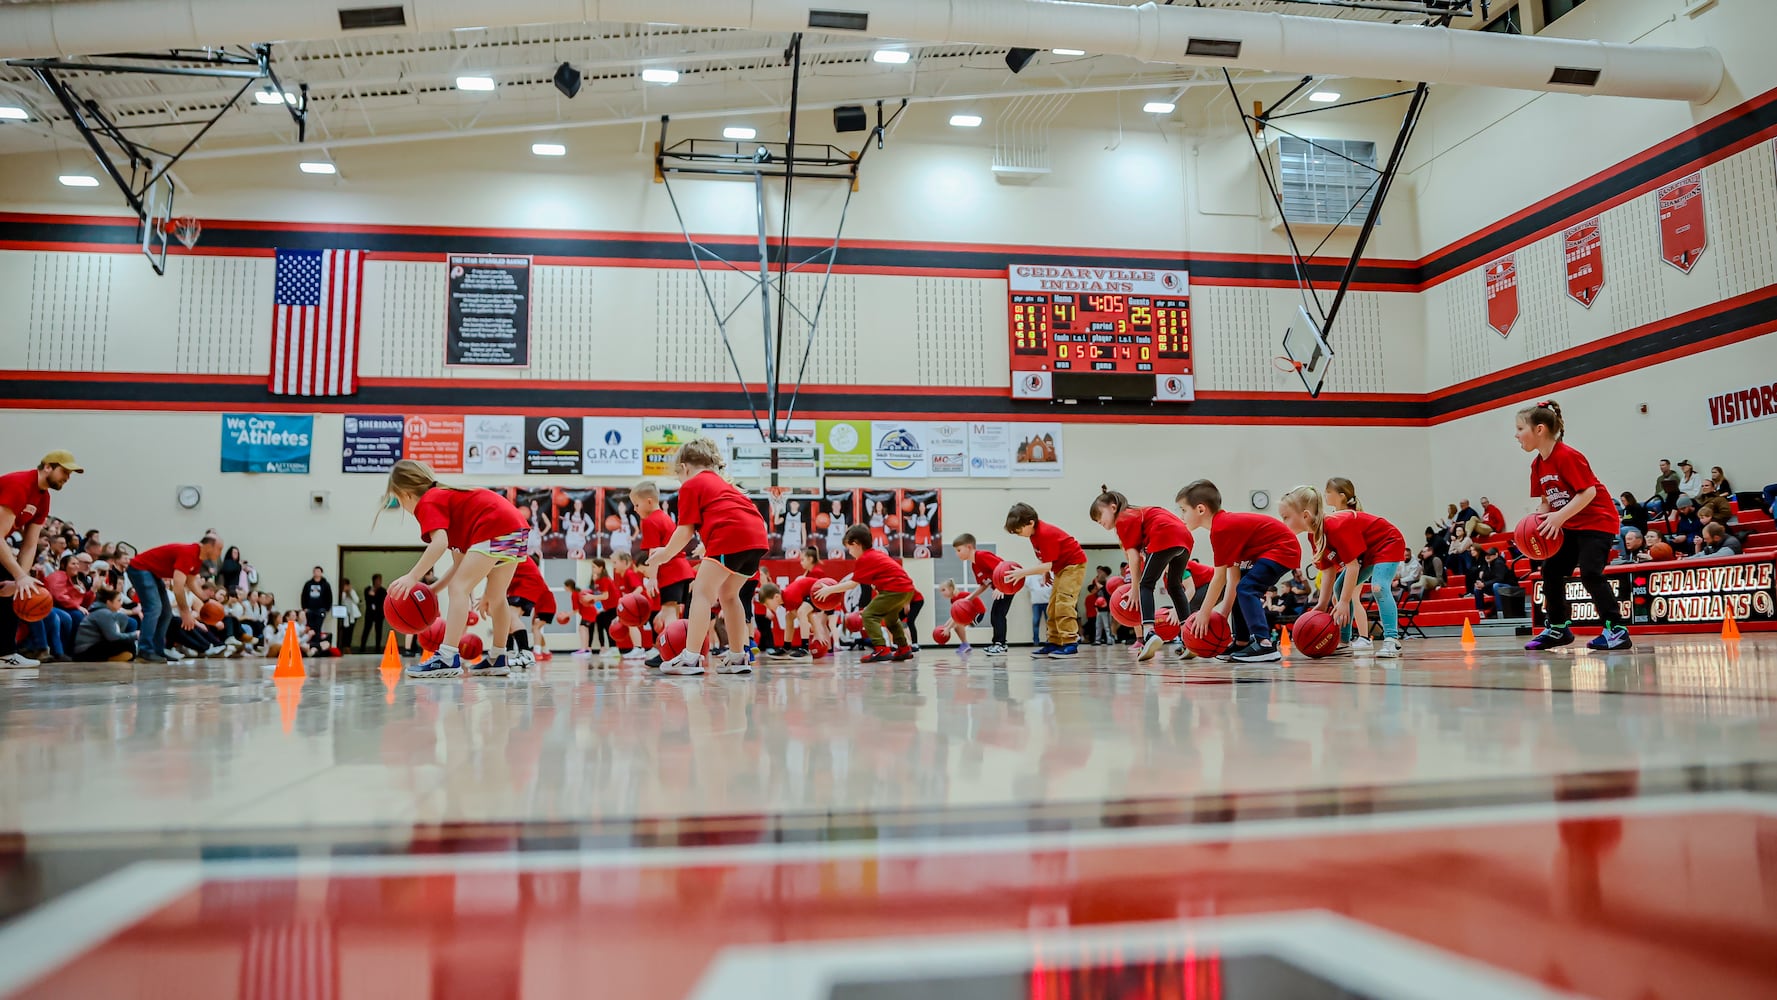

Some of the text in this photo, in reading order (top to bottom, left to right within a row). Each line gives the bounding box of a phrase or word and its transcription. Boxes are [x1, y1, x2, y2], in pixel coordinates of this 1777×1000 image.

[1016, 266, 1156, 282] CEDARVILLE
[1040, 280, 1134, 292] INDIANS
[1089, 295, 1124, 313] 4:05
[1054, 305, 1076, 321] 41
[1131, 306, 1152, 325] 25
[1091, 322, 1114, 331] period
[1118, 319, 1126, 333] 3
[1091, 333, 1113, 343] player
[1059, 344, 1068, 358] 0
[1122, 347, 1131, 359] 4
[1141, 346, 1150, 360] 0
[227, 417, 276, 430] We Care
[645, 423, 699, 434] COUNTRYSIDE
[237, 429, 309, 447] Athletes
[586, 448, 640, 460] GRACE
[1649, 563, 1773, 596] CEDARVILLE
[1632, 587, 1647, 595] POSS
[1668, 593, 1752, 622] INDIANS
